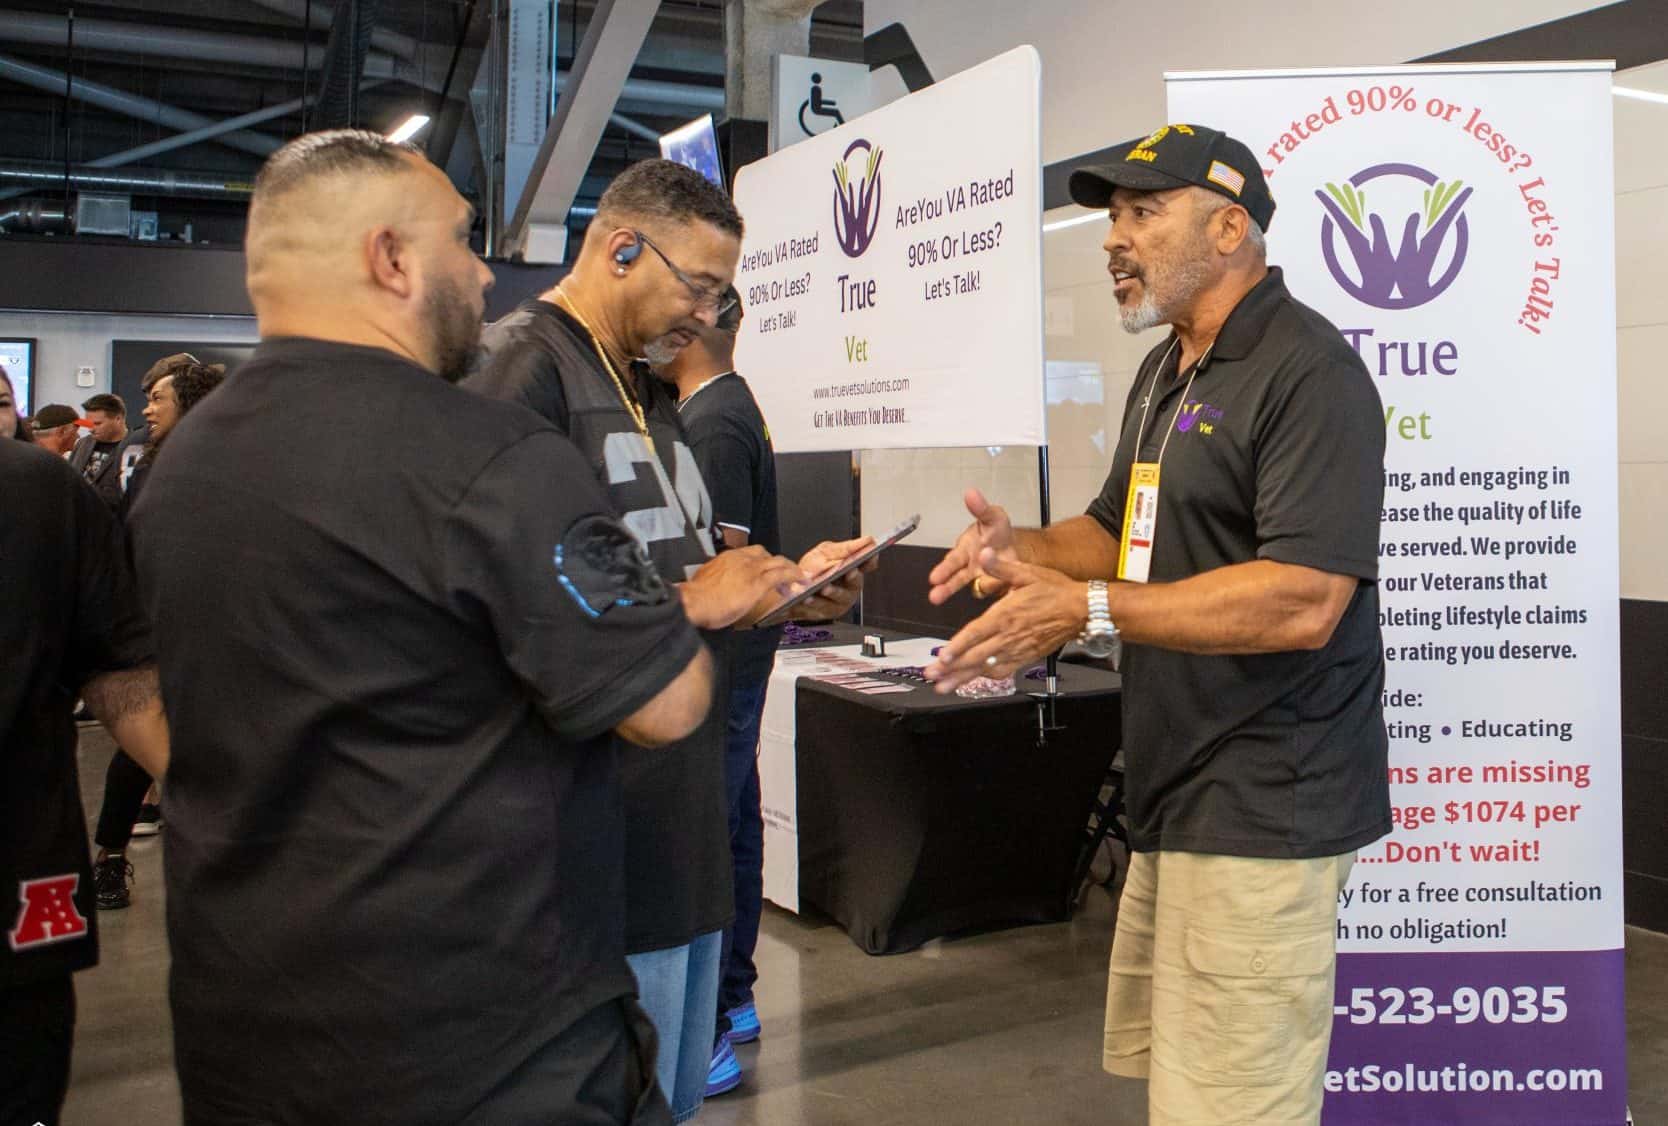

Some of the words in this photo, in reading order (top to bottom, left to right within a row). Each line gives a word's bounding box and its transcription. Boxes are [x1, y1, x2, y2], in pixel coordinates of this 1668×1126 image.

[1346, 85, 1417, 116] 90%
[1425, 98, 1462, 123] or
[1266, 95, 1343, 165] rated
[1462, 107, 1533, 174] less?
[946, 185, 966, 214] VA
[970, 167, 1014, 208] Rated
[1518, 176, 1560, 248] Let's
[774, 241, 788, 264] VA
[790, 231, 819, 260] Rated
[908, 239, 938, 269] 90%
[941, 235, 959, 260] Or
[962, 221, 1003, 256] Less?
[749, 283, 770, 307] 90%
[770, 280, 783, 301] Or
[784, 271, 811, 299] Less?
[837, 274, 877, 313] True
[924, 277, 951, 301] Let's
[952, 270, 981, 295] Talk!
[1517, 257, 1561, 335] Talk!
[759, 315, 777, 334] Let's
[778, 311, 797, 329] Talk!
[844, 335, 868, 364] Vet
[1341, 328, 1458, 376] True
[813, 377, 910, 400] www.truevetsolutions.com
[1420, 465, 1456, 487] and
[1459, 466, 1549, 491] engaging
[1552, 465, 1570, 485] in
[1422, 501, 1454, 522] the
[1457, 500, 1525, 527] quality
[1527, 499, 1548, 521] of
[1550, 499, 1582, 520] life
[1400, 535, 1468, 557] served.
[1470, 536, 1501, 556] We
[1504, 534, 1577, 561] provide
[1385, 577, 1418, 592] our
[1420, 572, 1505, 592] Veterans
[1508, 569, 1548, 591] that
[1445, 604, 1522, 630] lifestyle
[1525, 604, 1588, 625] claims
[1400, 641, 1458, 666] rating
[1460, 645, 1495, 665] you
[1498, 639, 1577, 660] deserve.
[1383, 689, 1424, 708] ide:
[1387, 720, 1432, 743] ting
[1461, 718, 1573, 742] Educating
[1387, 765, 1419, 785] ns
[1426, 766, 1473, 785] are
[1482, 759, 1591, 789] missing
[1444, 800, 1527, 825] $1074
[1534, 804, 1582, 829] per
[1468, 839, 1540, 863] wait!
[1359, 881, 1393, 904] for
[1397, 888, 1411, 903] a
[1415, 881, 1459, 903] free
[1465, 880, 1602, 903] consultation
[1355, 924, 1384, 940] no
[1389, 917, 1507, 945] obligation!
[1333, 985, 1568, 1025] -523-9035
[1323, 1062, 1603, 1093] etSolution.com
